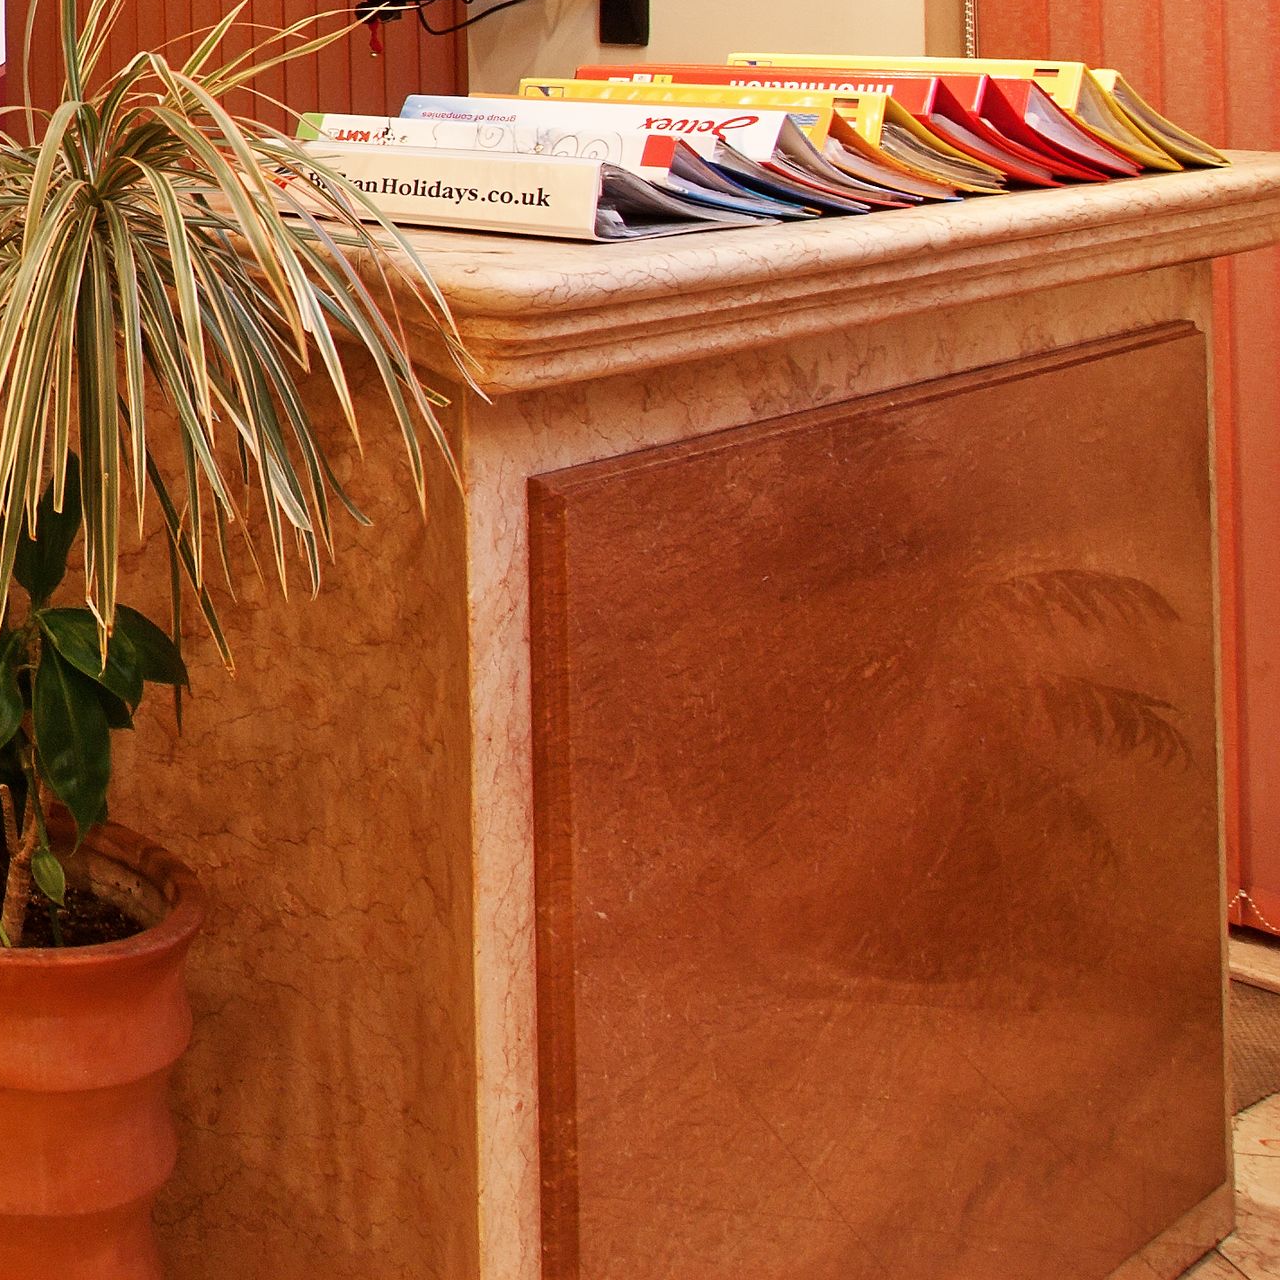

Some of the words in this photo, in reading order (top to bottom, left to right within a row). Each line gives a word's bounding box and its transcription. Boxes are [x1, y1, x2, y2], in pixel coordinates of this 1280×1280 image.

[420, 111, 473, 122] companies
[474, 114, 485, 122] of
[487, 114, 517, 123] group
[308, 172, 551, 208] BanHolidays.co.uk
